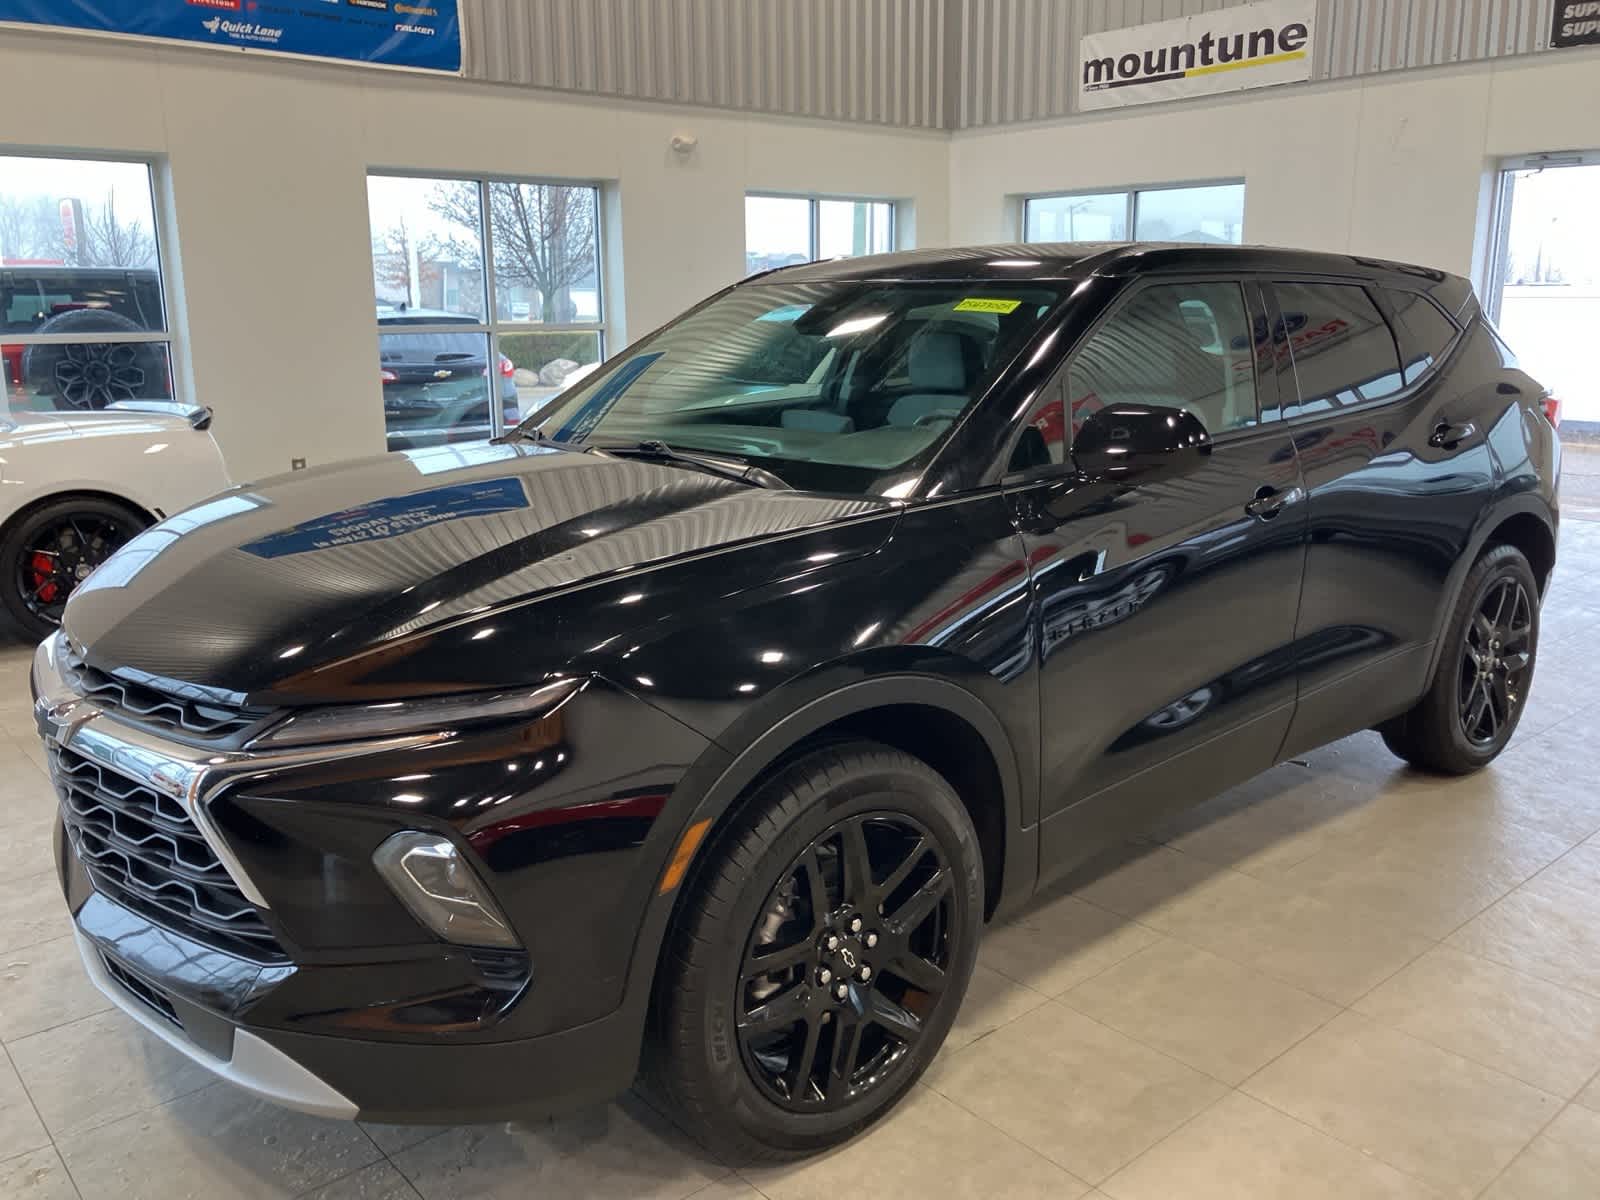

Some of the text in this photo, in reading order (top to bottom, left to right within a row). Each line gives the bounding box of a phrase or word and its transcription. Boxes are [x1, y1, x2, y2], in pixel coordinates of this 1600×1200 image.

[221, 20, 283, 38] Quick Lane
[1083, 22, 1308, 84] mountune
